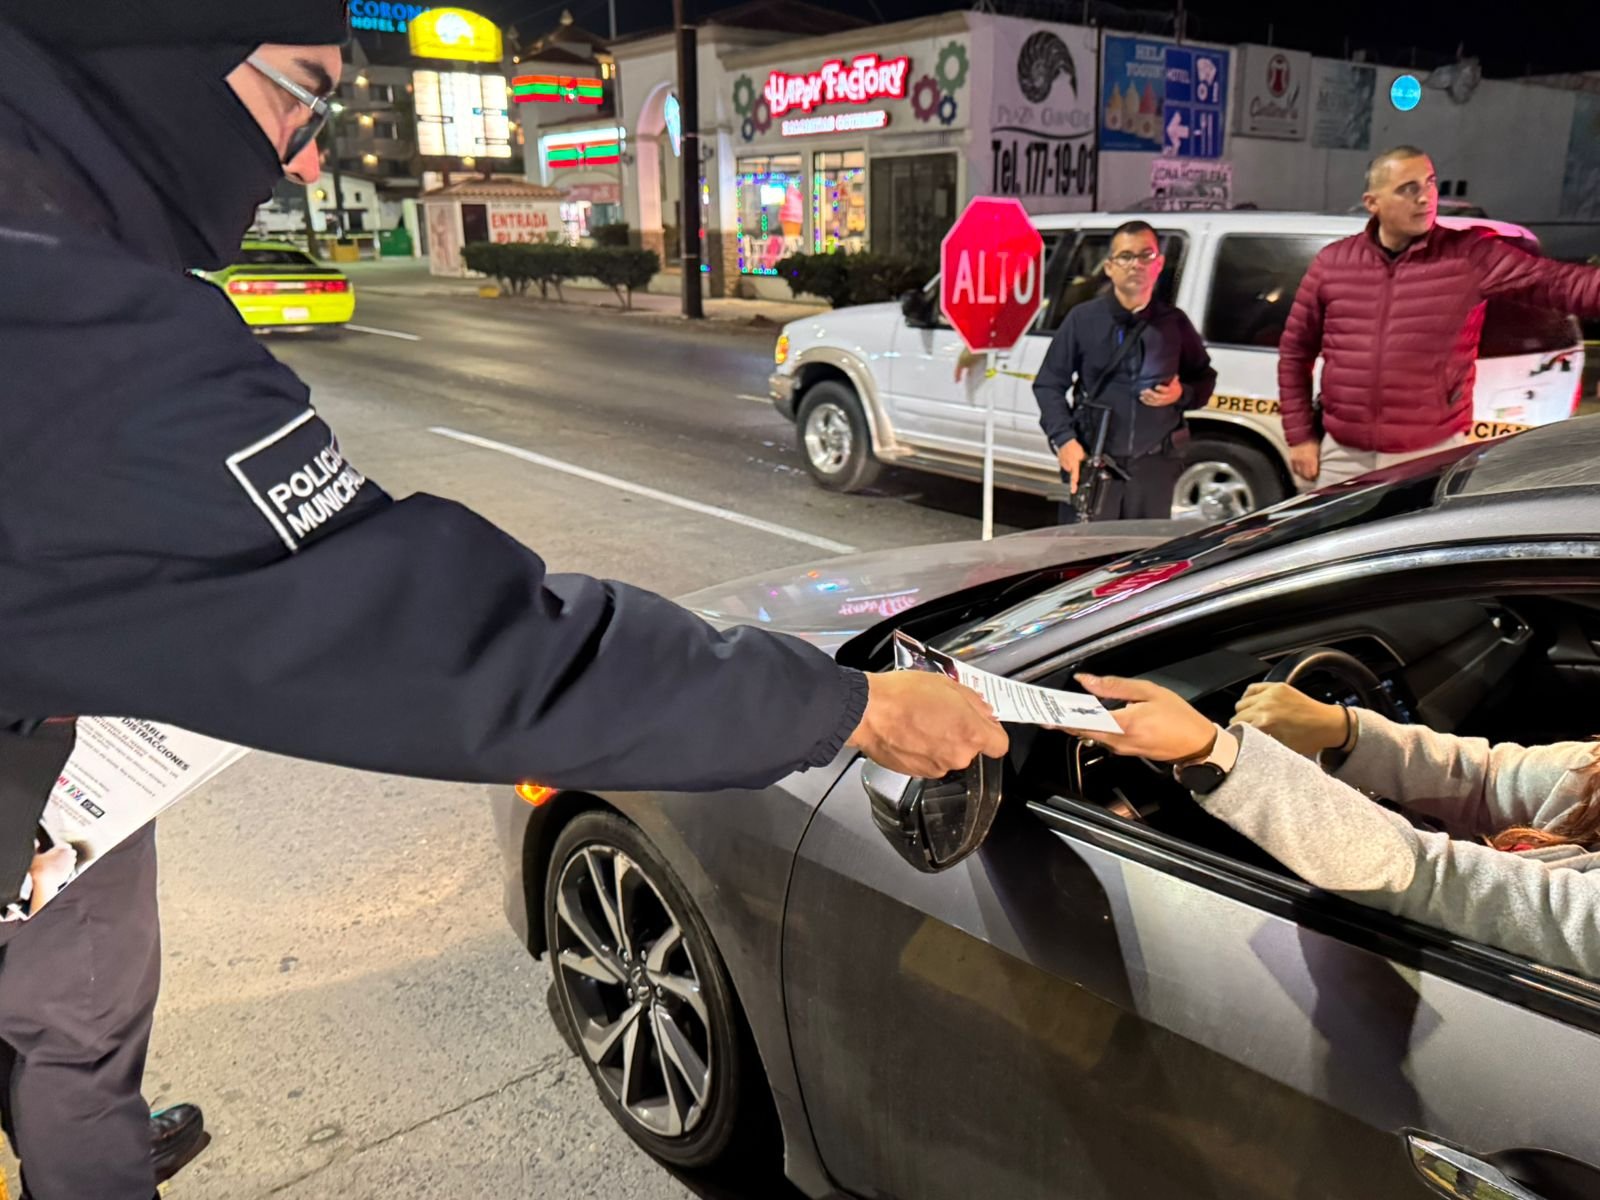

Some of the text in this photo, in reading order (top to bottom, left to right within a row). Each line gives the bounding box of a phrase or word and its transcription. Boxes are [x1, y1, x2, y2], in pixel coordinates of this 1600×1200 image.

[351, 16, 395, 32] HOTEL
[821, 56, 905, 101] FACTORY
[992, 140, 1021, 194] Tel.
[491, 212, 547, 229] ENTRADA
[952, 250, 1035, 305] ALTO
[121, 717, 190, 772] DISTRACCIONES
